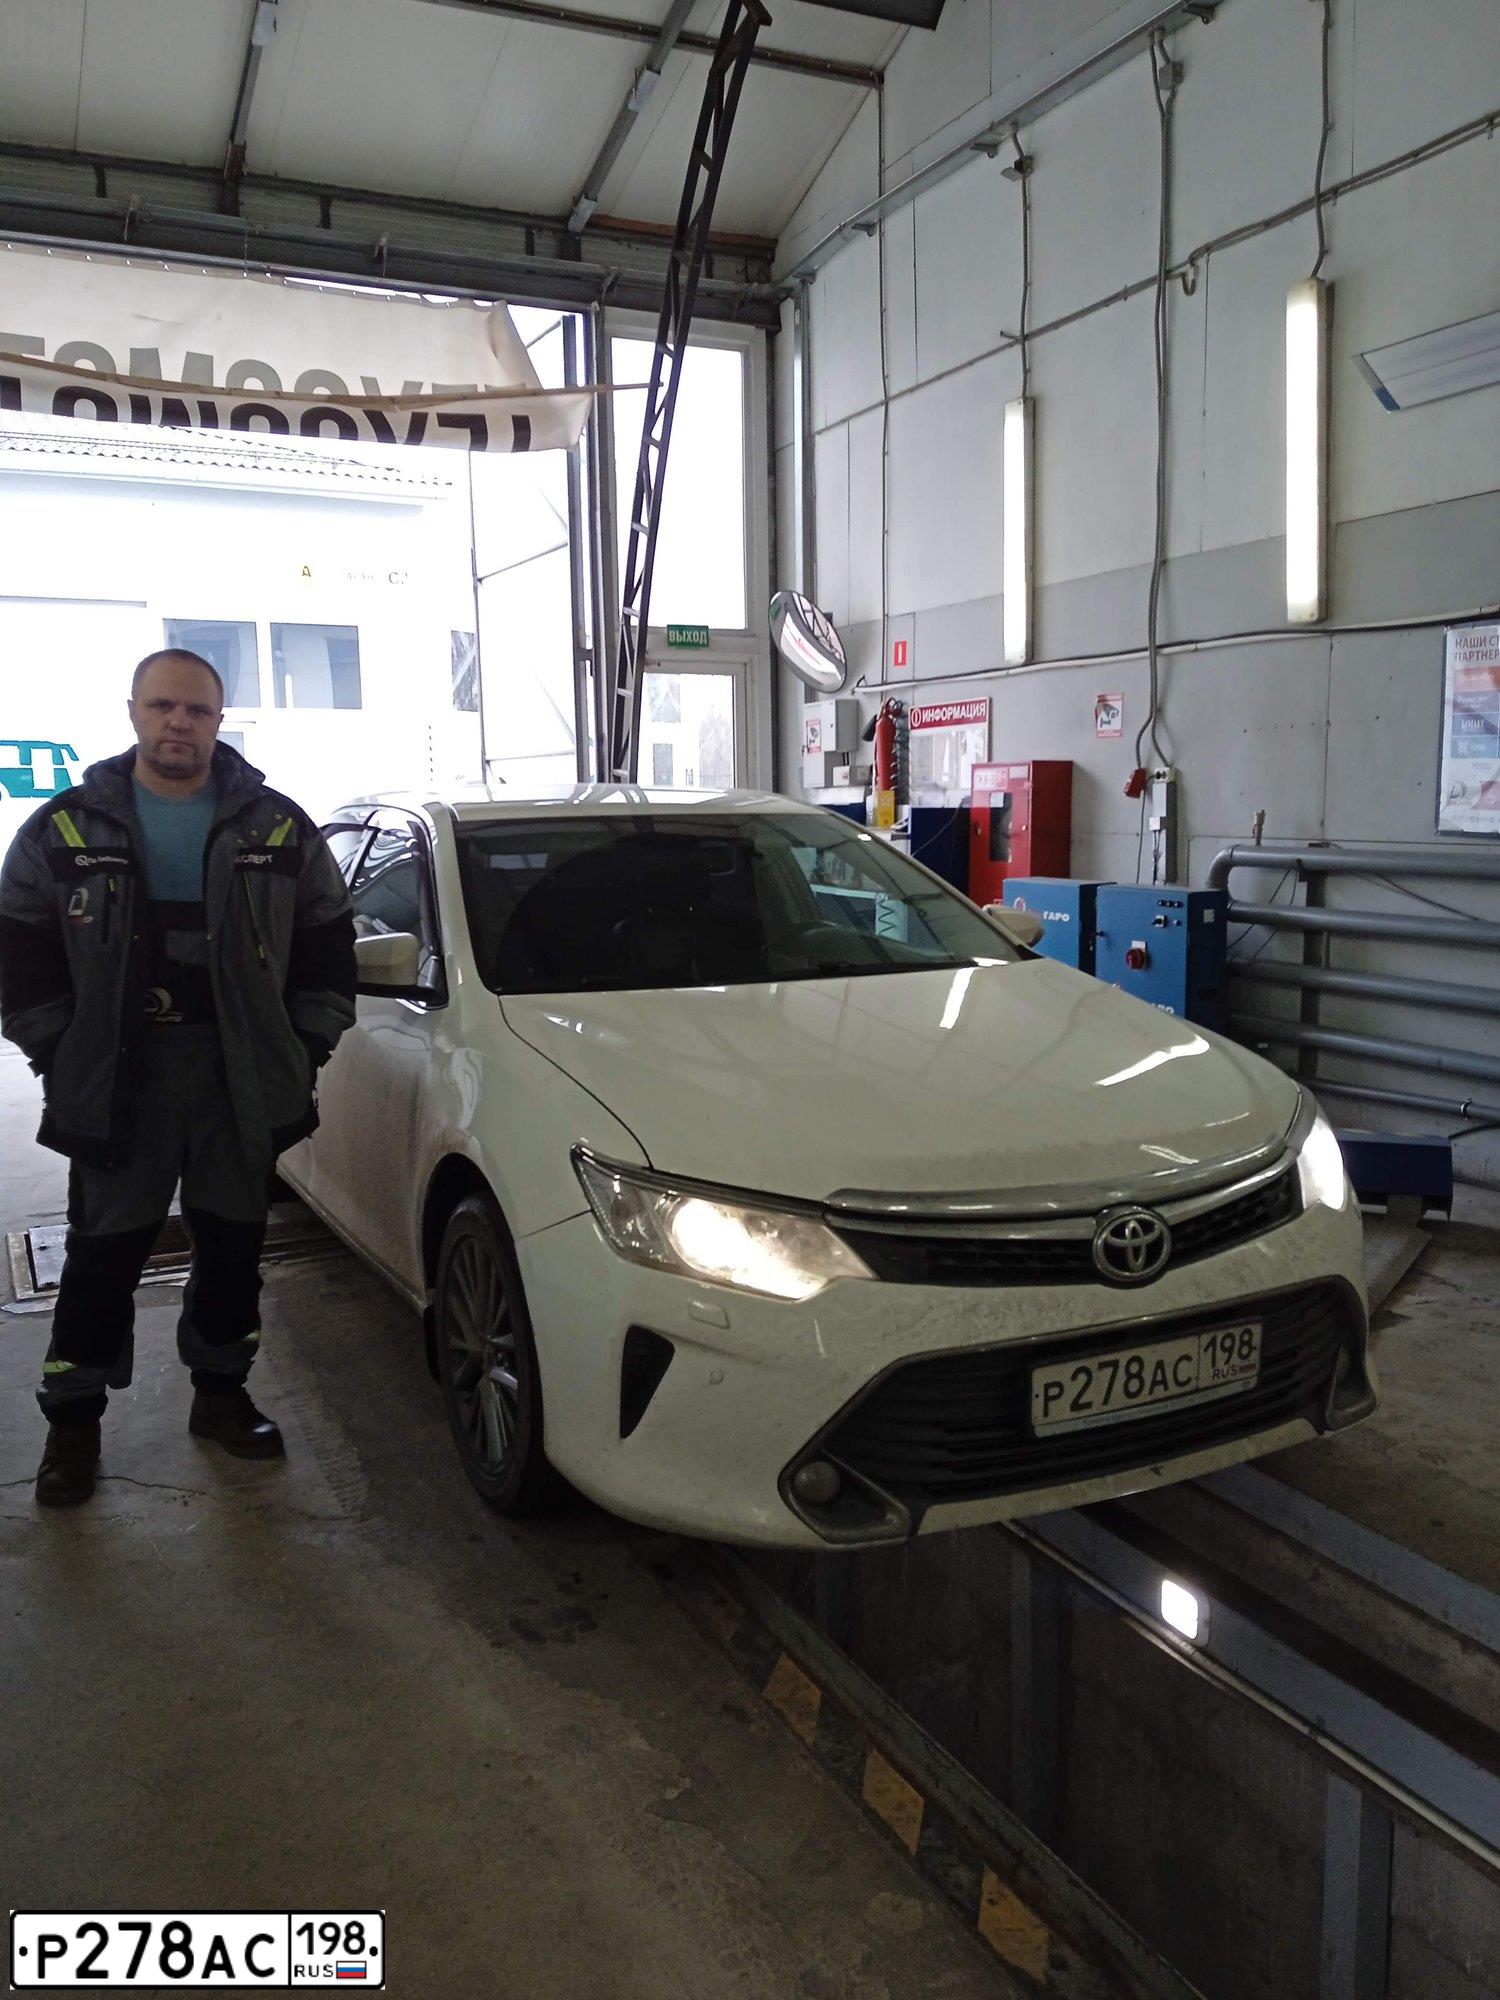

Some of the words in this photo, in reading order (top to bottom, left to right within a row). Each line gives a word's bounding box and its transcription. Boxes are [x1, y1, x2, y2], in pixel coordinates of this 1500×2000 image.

[669, 630, 708, 645] ВЫХОД
[1455, 636, 1487, 649] НАШИ
[922, 702, 986, 724] ИНФОРМАЦИЯ
[1043, 911, 1070, 922] ГАРО
[1042, 1355, 1194, 1418] Р278АС
[1203, 1328, 1254, 1370] 198
[1212, 1365, 1237, 1380] RUS
